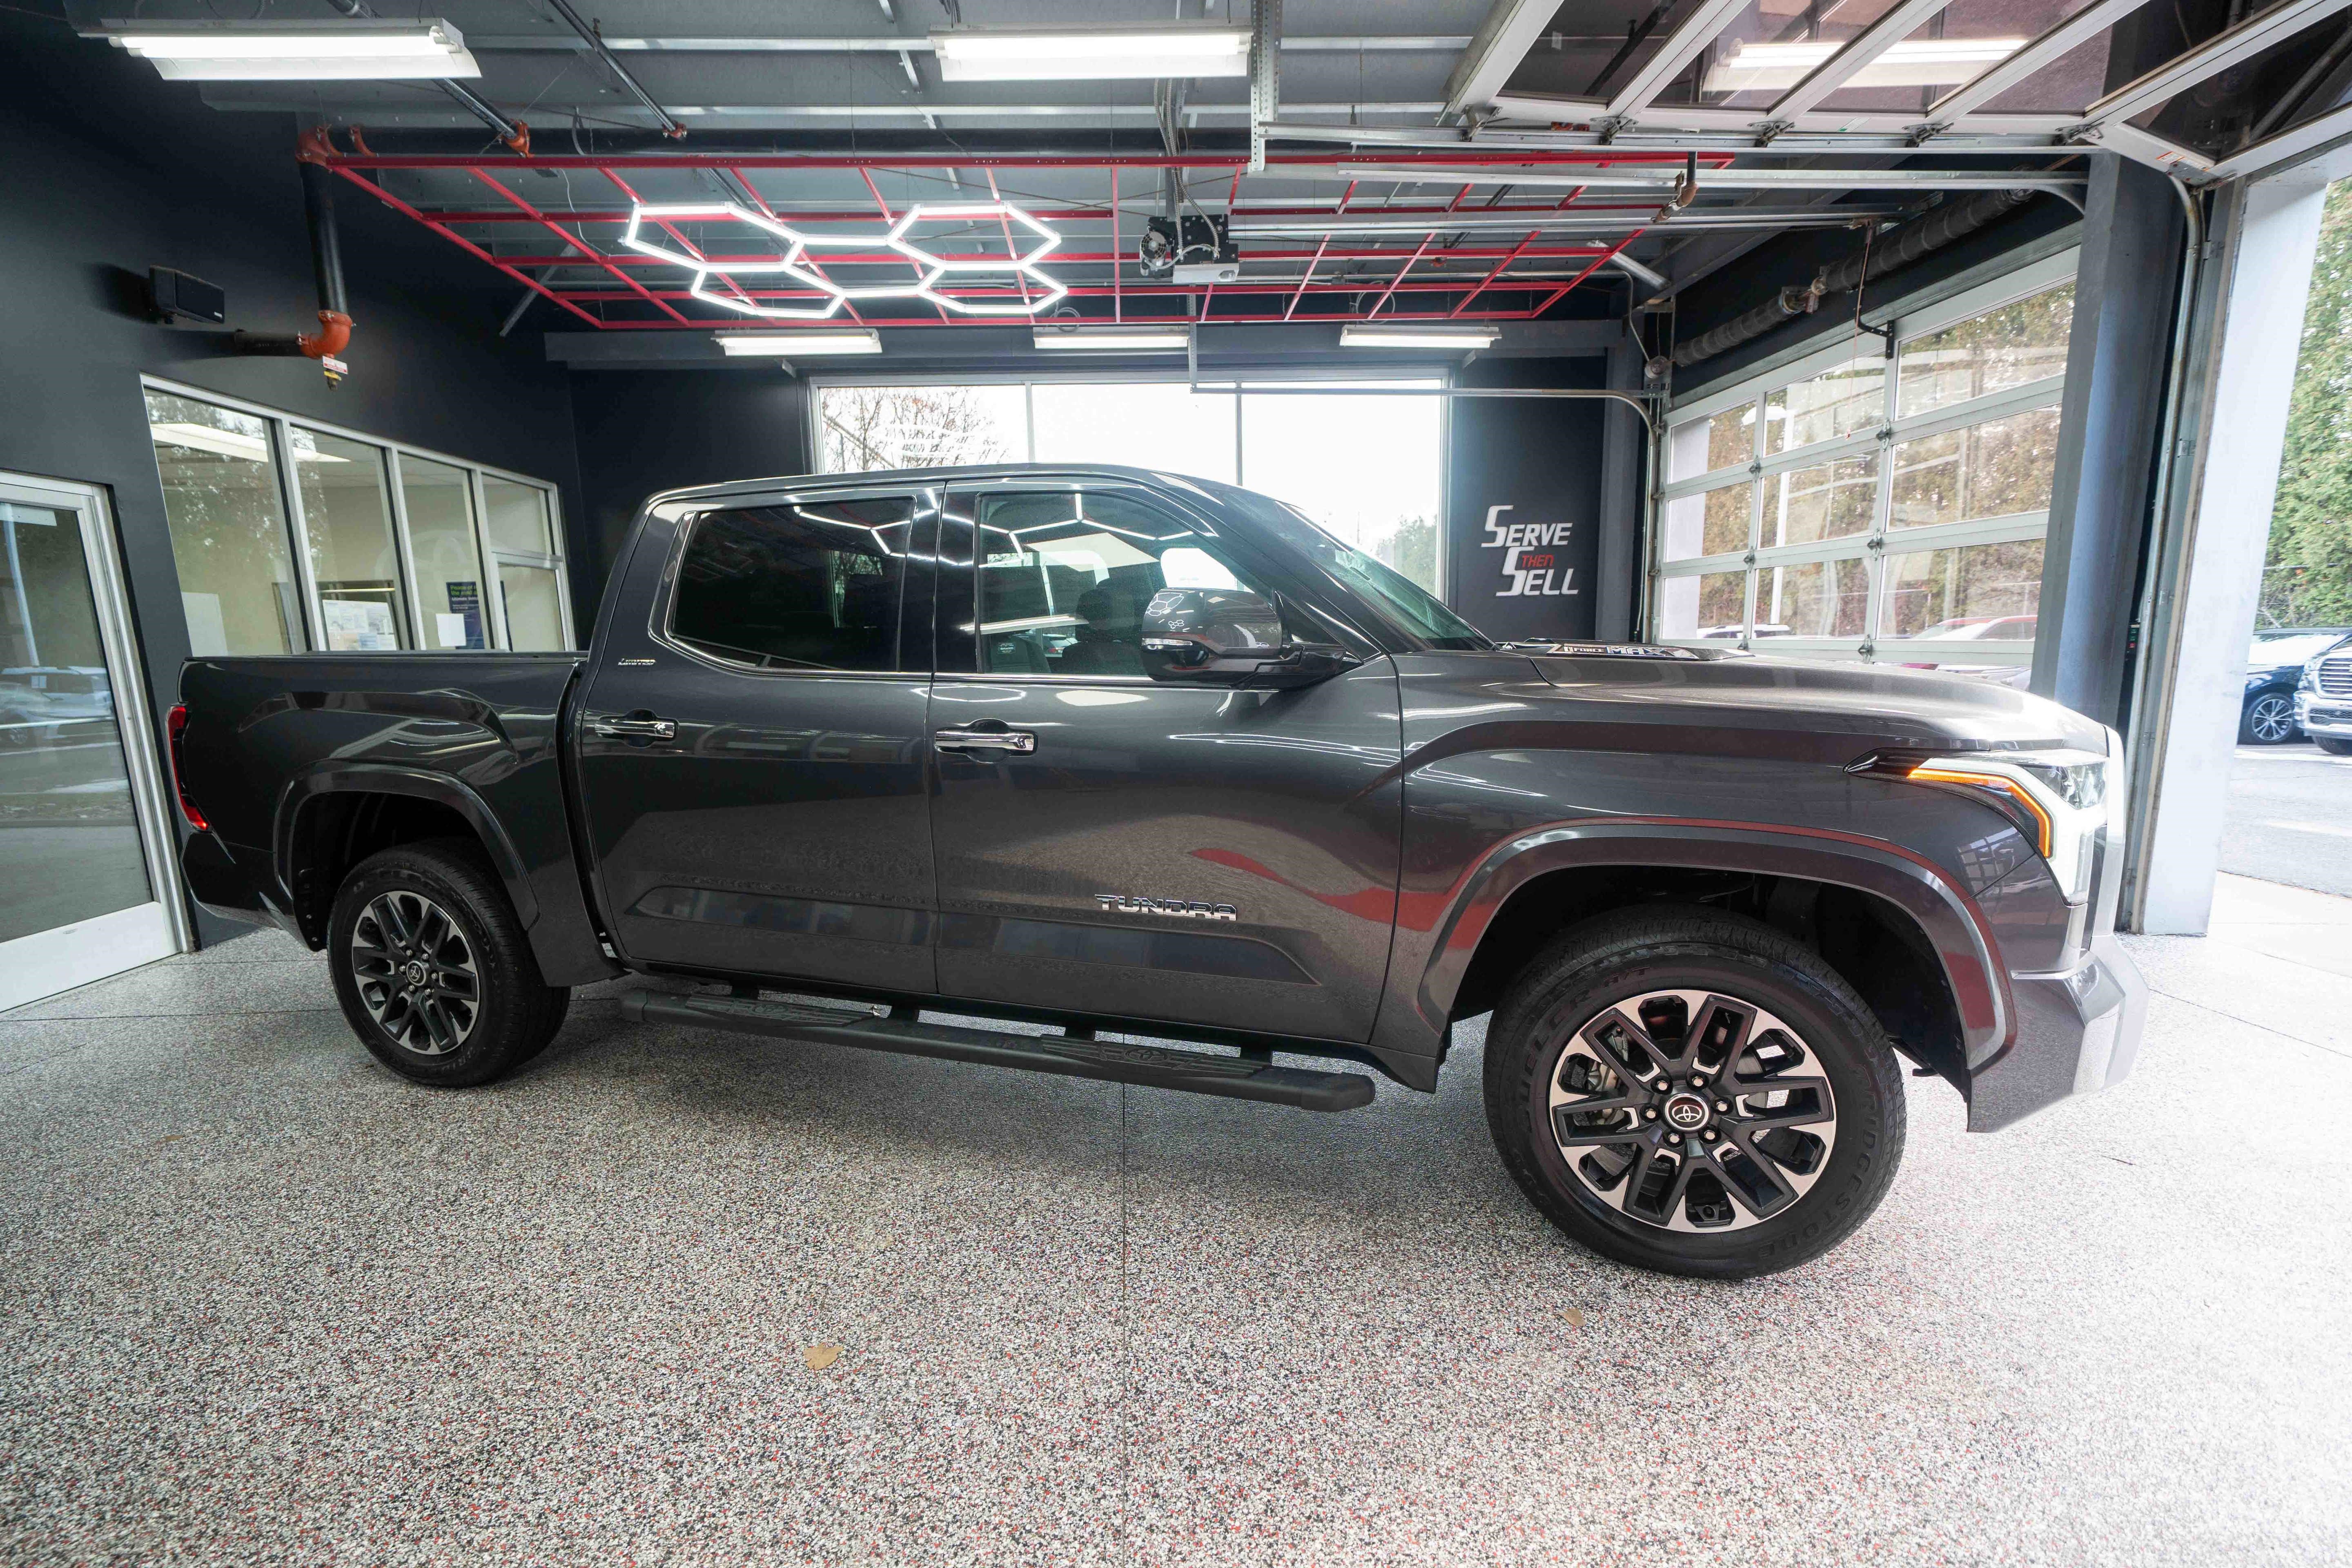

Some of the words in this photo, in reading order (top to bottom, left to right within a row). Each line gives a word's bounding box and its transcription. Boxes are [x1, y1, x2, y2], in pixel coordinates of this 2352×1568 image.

[1481, 505, 1572, 547] SERVE
[1496, 546, 1579, 596] SELL
[1606, 646, 1675, 657] MAX
[1095, 894, 1238, 922] TUNDRA
